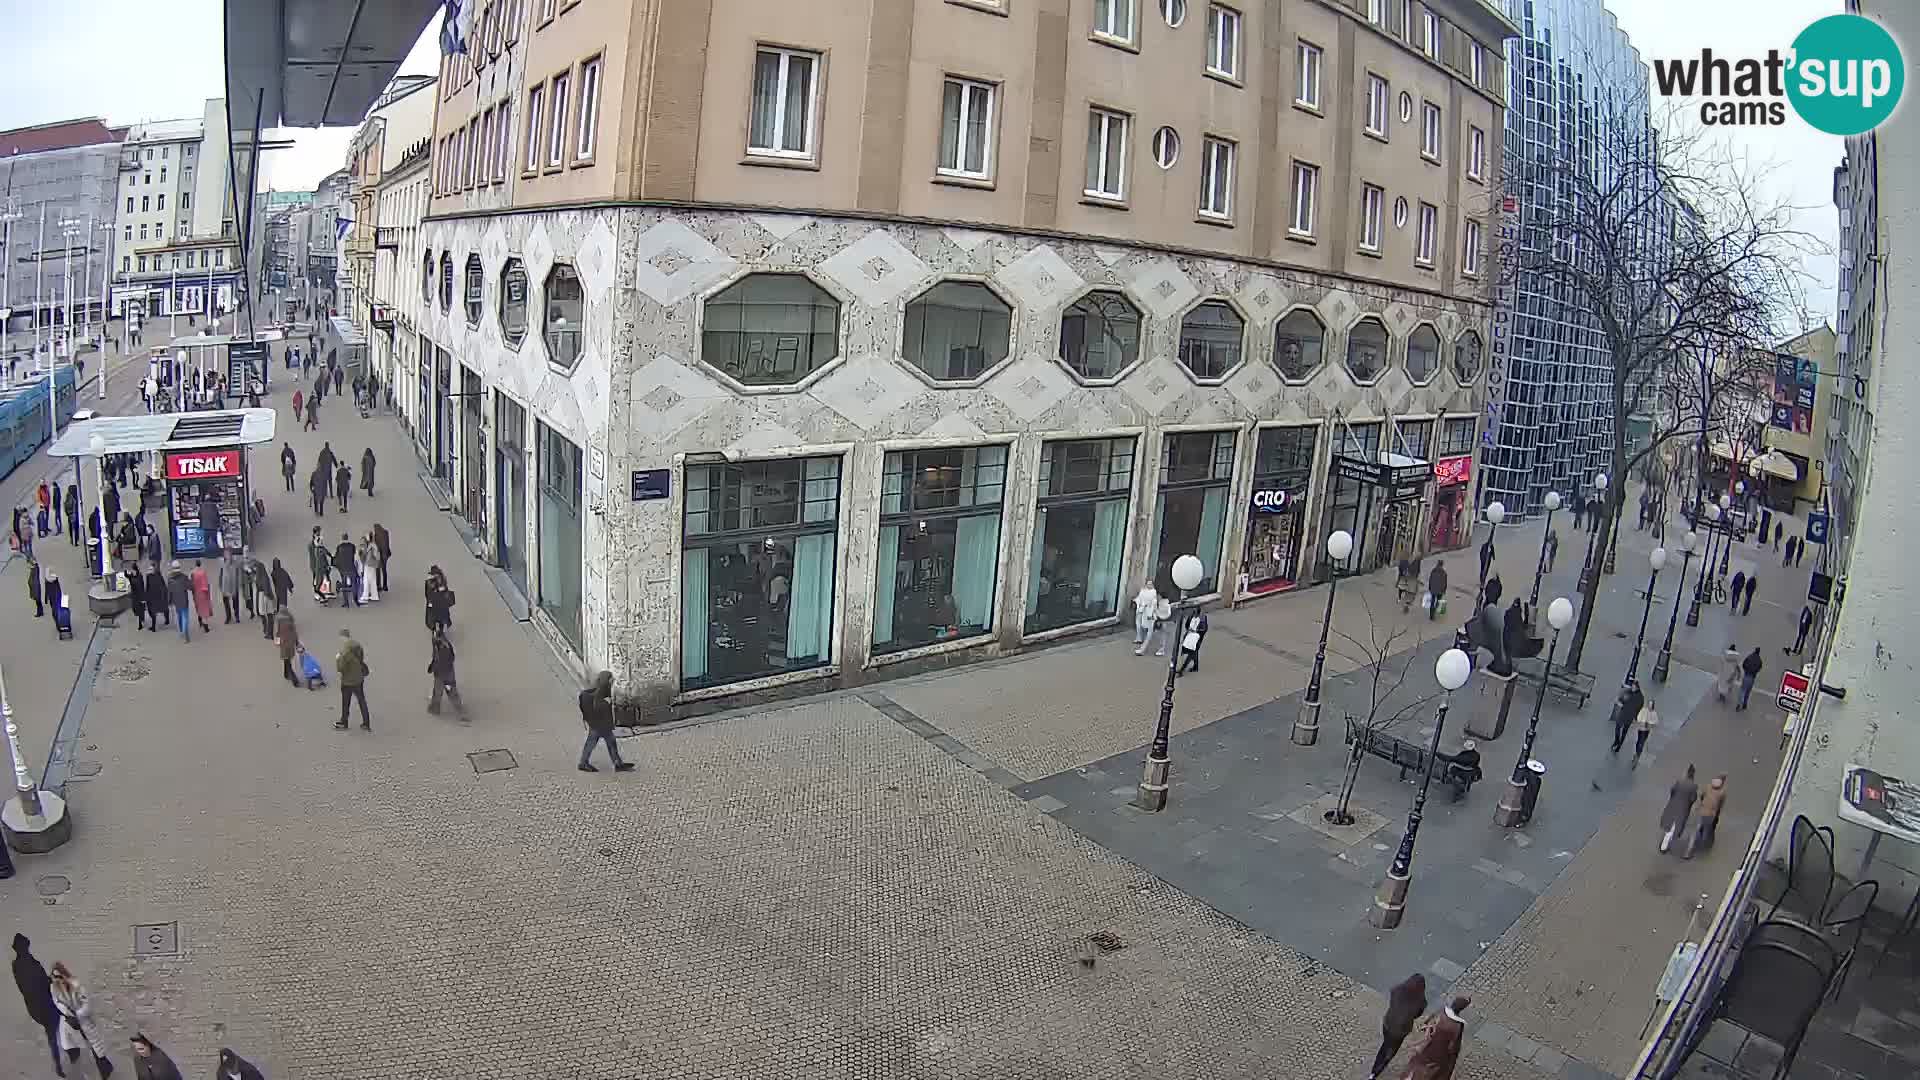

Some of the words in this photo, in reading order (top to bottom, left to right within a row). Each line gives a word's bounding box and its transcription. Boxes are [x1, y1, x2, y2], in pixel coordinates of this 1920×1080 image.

[1483, 312, 1508, 445] DUBROVNIK
[179, 456, 228, 475] TISAK
[1254, 490, 1286, 506] CRO
